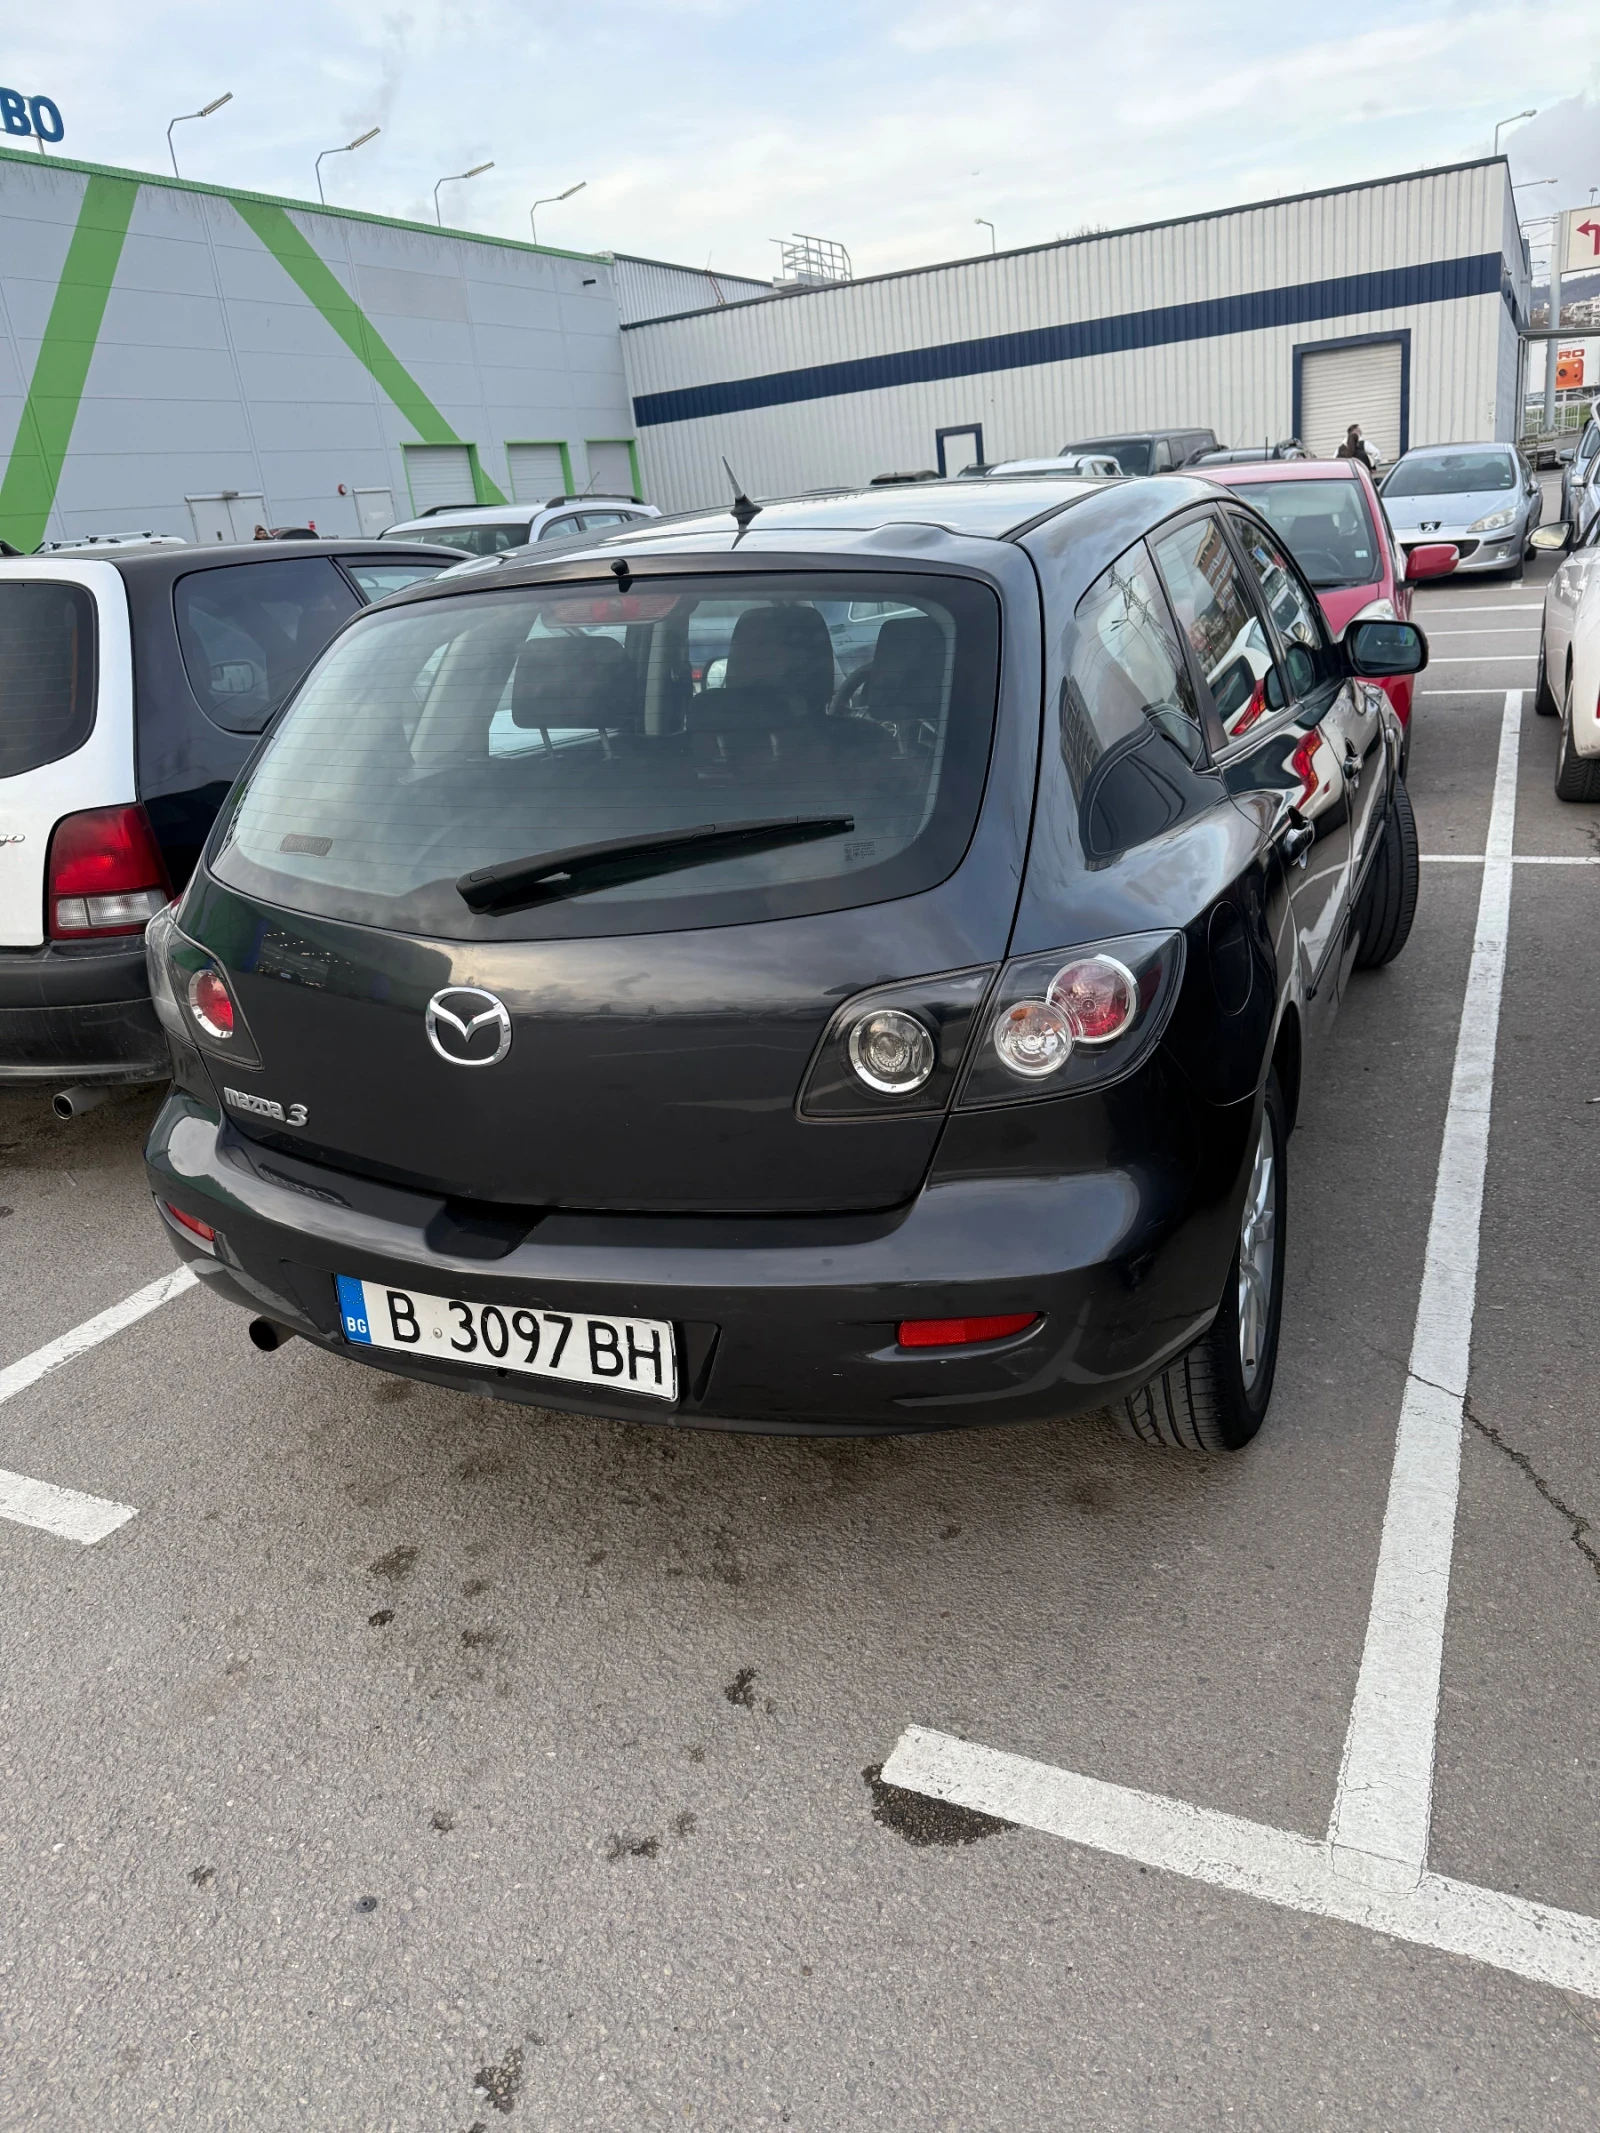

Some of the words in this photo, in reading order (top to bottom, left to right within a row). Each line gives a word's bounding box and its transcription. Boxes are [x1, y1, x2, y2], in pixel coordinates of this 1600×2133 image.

[286, 1103, 309, 1127] 3
[346, 1316, 367, 1334] BG
[386, 1290, 421, 1343] B
[448, 1301, 573, 1368] 3097
[587, 1320, 663, 1385] BH
